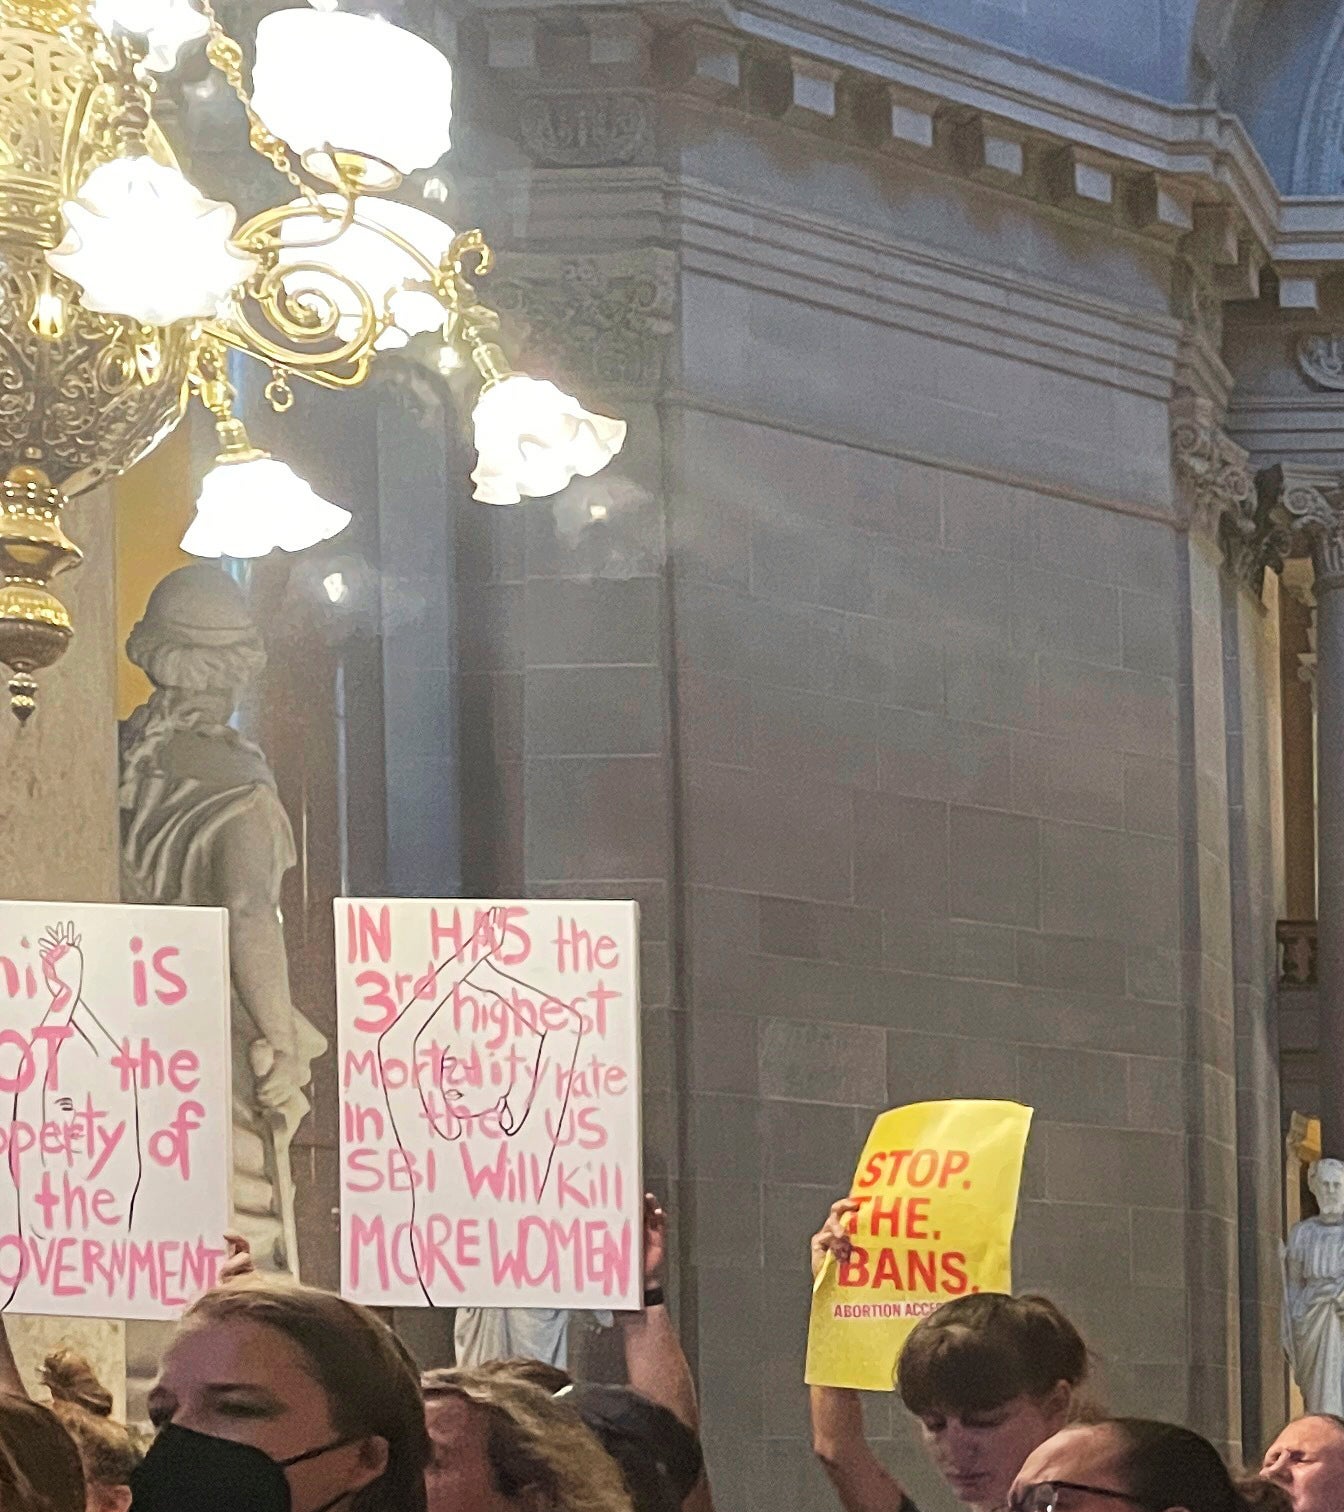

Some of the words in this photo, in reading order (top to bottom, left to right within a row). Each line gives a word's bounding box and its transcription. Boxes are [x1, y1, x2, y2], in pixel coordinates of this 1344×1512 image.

[347, 903, 391, 964] IN
[430, 906, 531, 965] HAS
[553, 916, 619, 973] the
[130, 936, 187, 1006] is
[353, 962, 437, 1033] 3rd
[453, 979, 622, 1051] highest
[0, 1026, 74, 1092] OT
[111, 1037, 200, 1093] the
[343, 1039, 551, 1090] Mortality
[555, 1055, 628, 1099] rate
[149, 1101, 206, 1181] of
[419, 1091, 503, 1140] the
[545, 1106, 608, 1149] US
[459, 1141, 542, 1202] Will
[858, 1148, 971, 1190] STOP.
[35, 1170, 122, 1230] the
[846, 1196, 941, 1240] THE.
[0, 1234, 226, 1306] OVERNMENT
[349, 1213, 480, 1293] MORE
[488, 1215, 632, 1297] WOMEN
[837, 1245, 981, 1295] BANS.
[834, 1303, 901, 1318] ABORTION
[904, 1302, 945, 1317] ACCE
